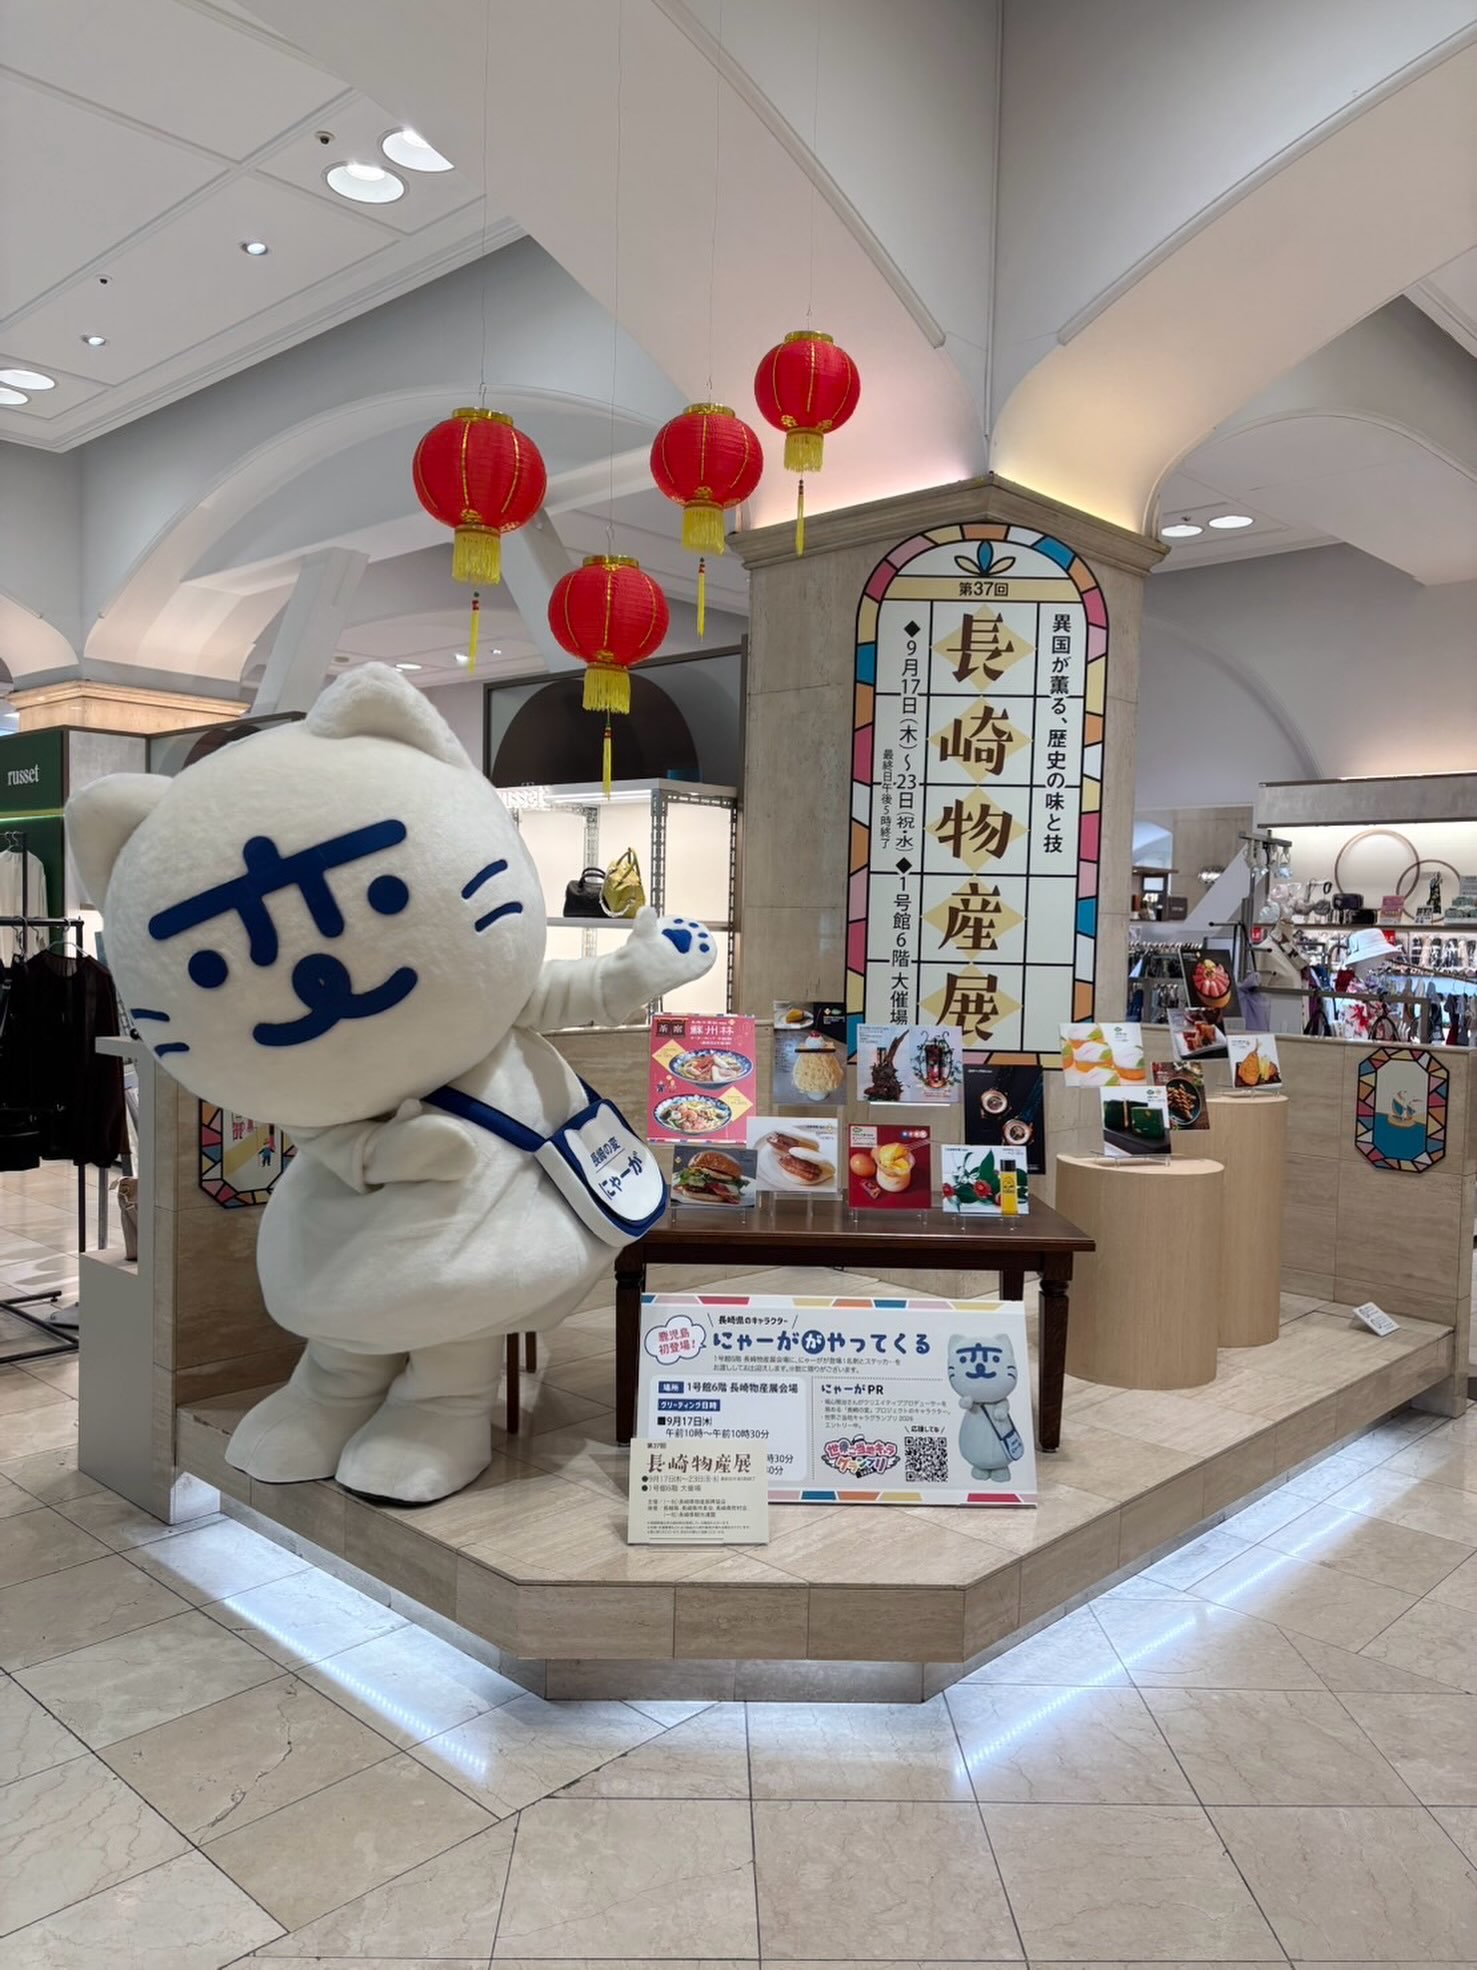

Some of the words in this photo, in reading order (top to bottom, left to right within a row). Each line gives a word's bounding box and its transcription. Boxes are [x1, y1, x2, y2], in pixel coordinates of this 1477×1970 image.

[959, 581, 1009, 597] 第37回
[1043, 613, 1072, 854] 異国が薫る、歴史の味と技
[7, 764, 40, 786] russet
[935, 612, 1014, 1041] 長崎物産展
[598, 1150, 643, 1201] にゃーが
[719, 1315, 788, 1326] 長崎県のキャラクター
[658, 1327, 690, 1342] 鹿児島
[658, 1339, 696, 1356] 初登場!
[687, 1382, 727, 1392] 1号館6階
[730, 1382, 799, 1394] 長崎物産展会場
[821, 1383, 884, 1395] にゃーがPR
[660, 1401, 718, 1410] グリーティング日時
[647, 1453, 751, 1473] 長崎物産展
